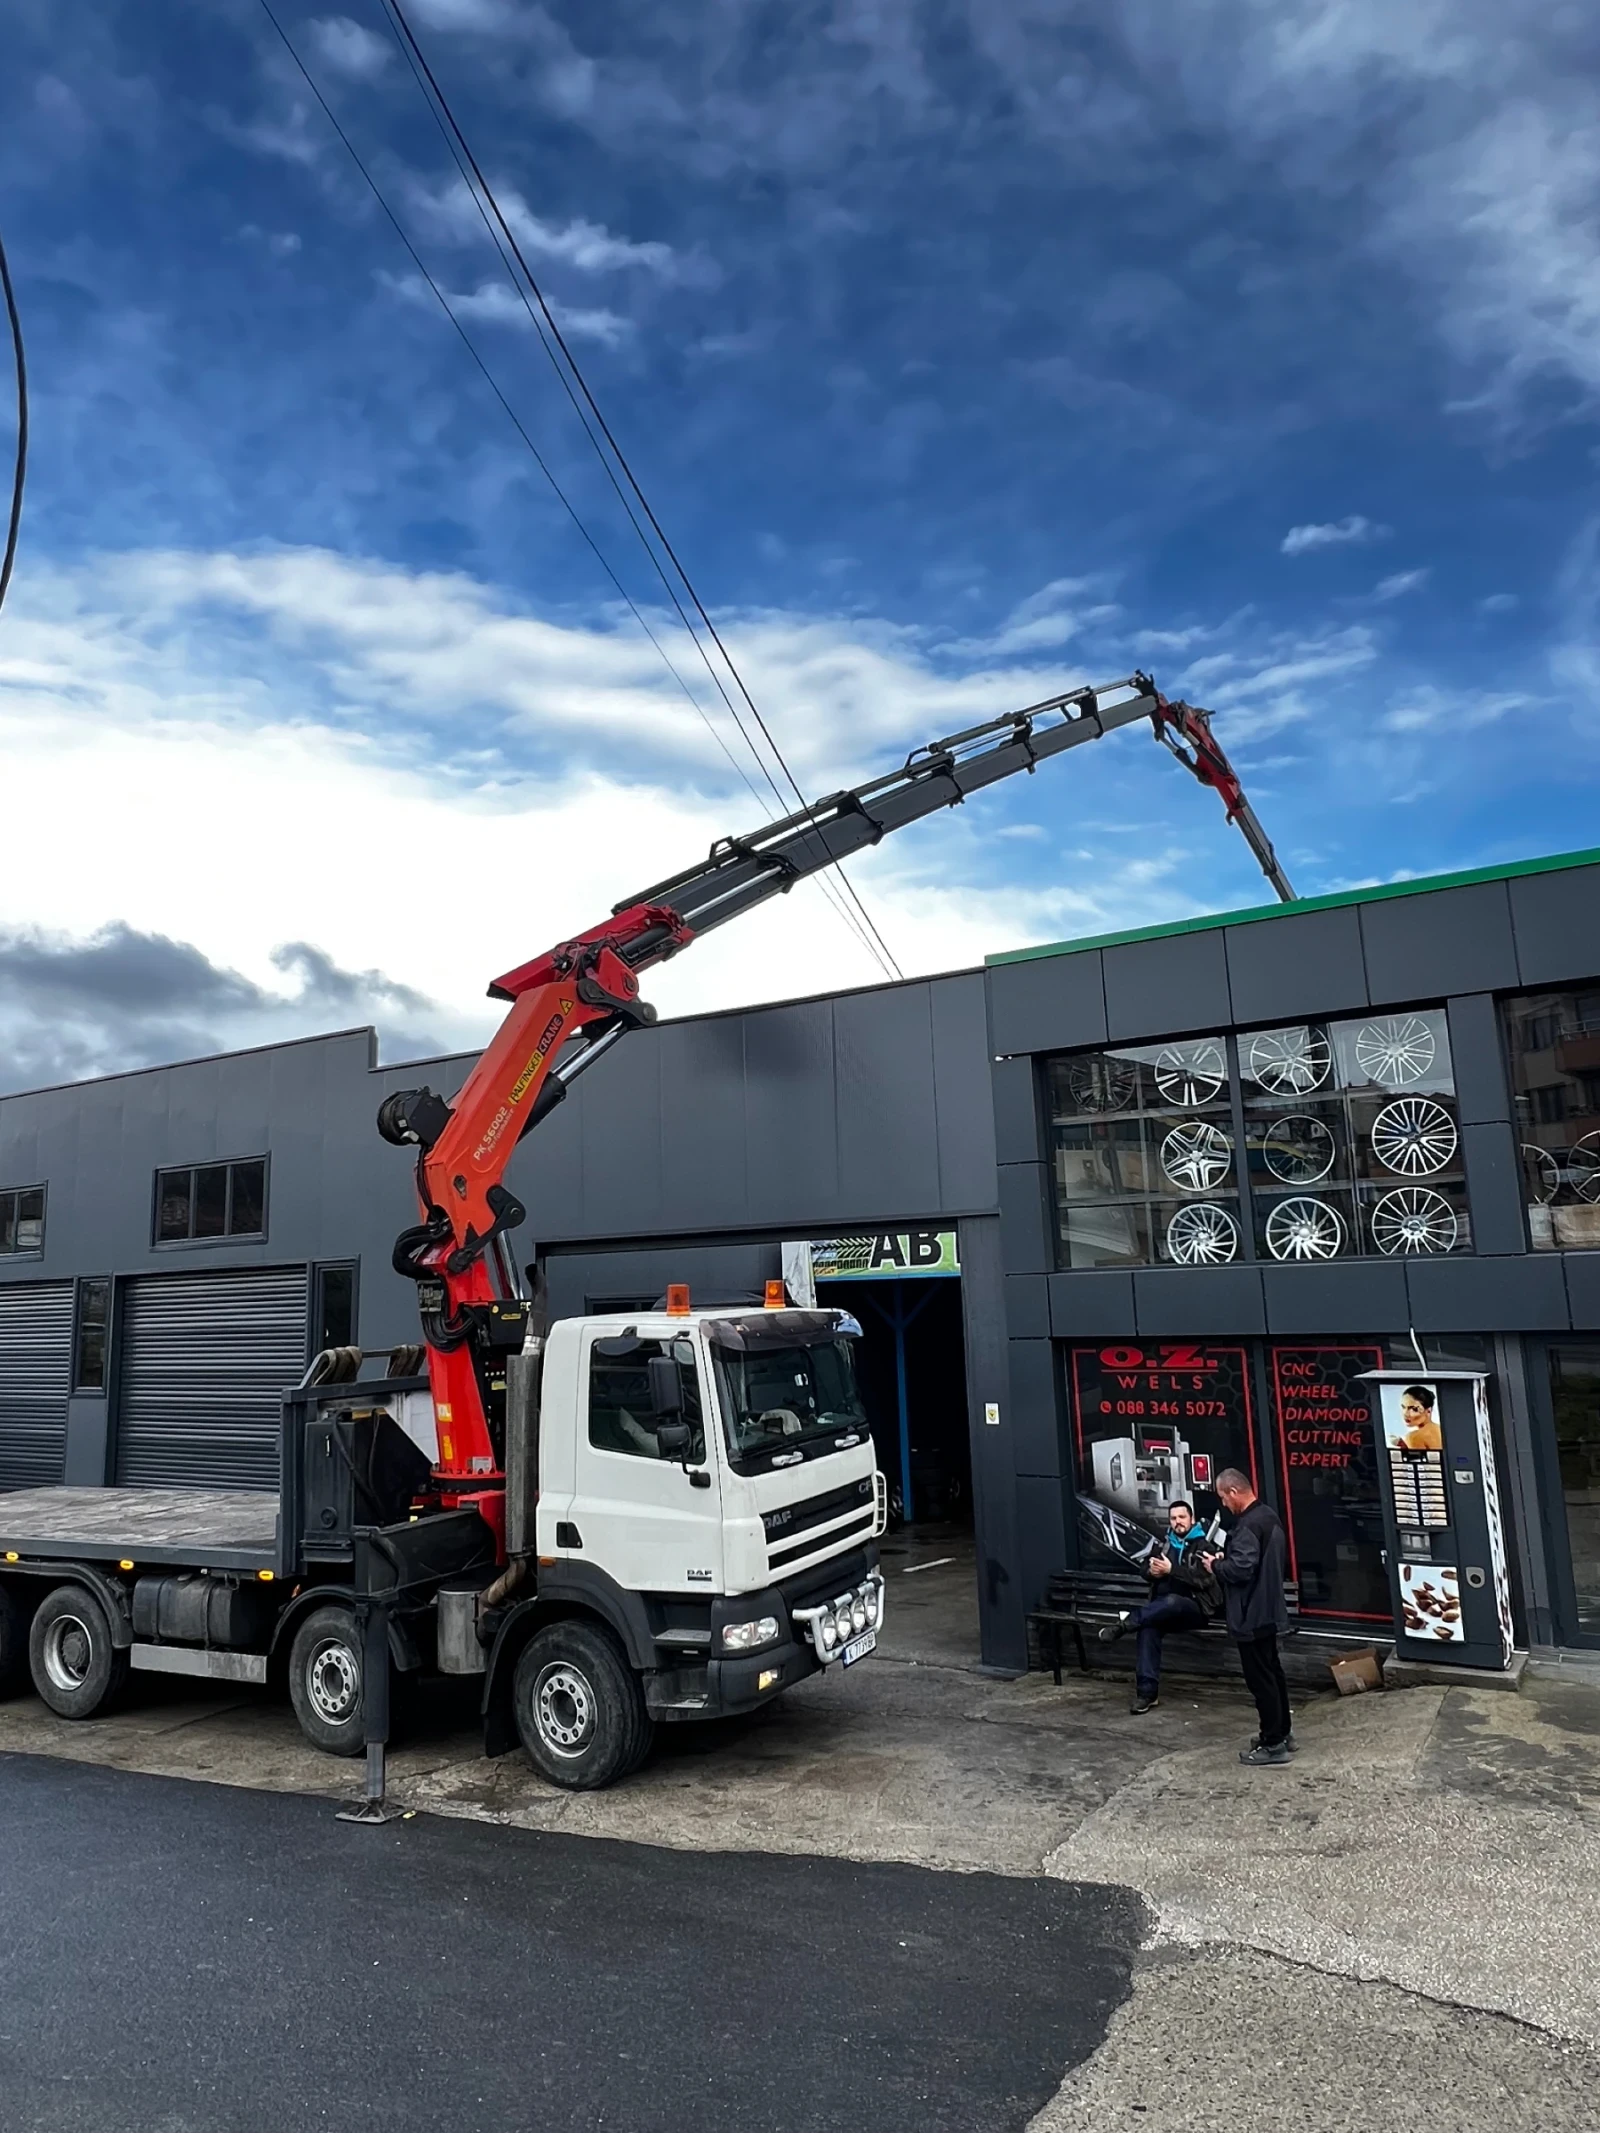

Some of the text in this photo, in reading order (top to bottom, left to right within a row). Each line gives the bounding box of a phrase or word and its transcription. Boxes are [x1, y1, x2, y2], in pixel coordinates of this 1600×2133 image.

[510, 1016, 563, 1103] PALFINGER CRANE
[473, 1107, 509, 1161] PK 56002
[1100, 1345, 1218, 1368] O.Z.
[1281, 1363, 1317, 1376] CNC
[1117, 1375, 1204, 1390] WELS
[1282, 1385, 1339, 1398] WHEEL
[1116, 1401, 1227, 1417] 088 346 5072
[1285, 1407, 1369, 1422] DIAMOND
[1287, 1430, 1363, 1446] CUTTING
[1289, 1452, 1352, 1468] EXPERT
[762, 1510, 793, 1530] DAF
